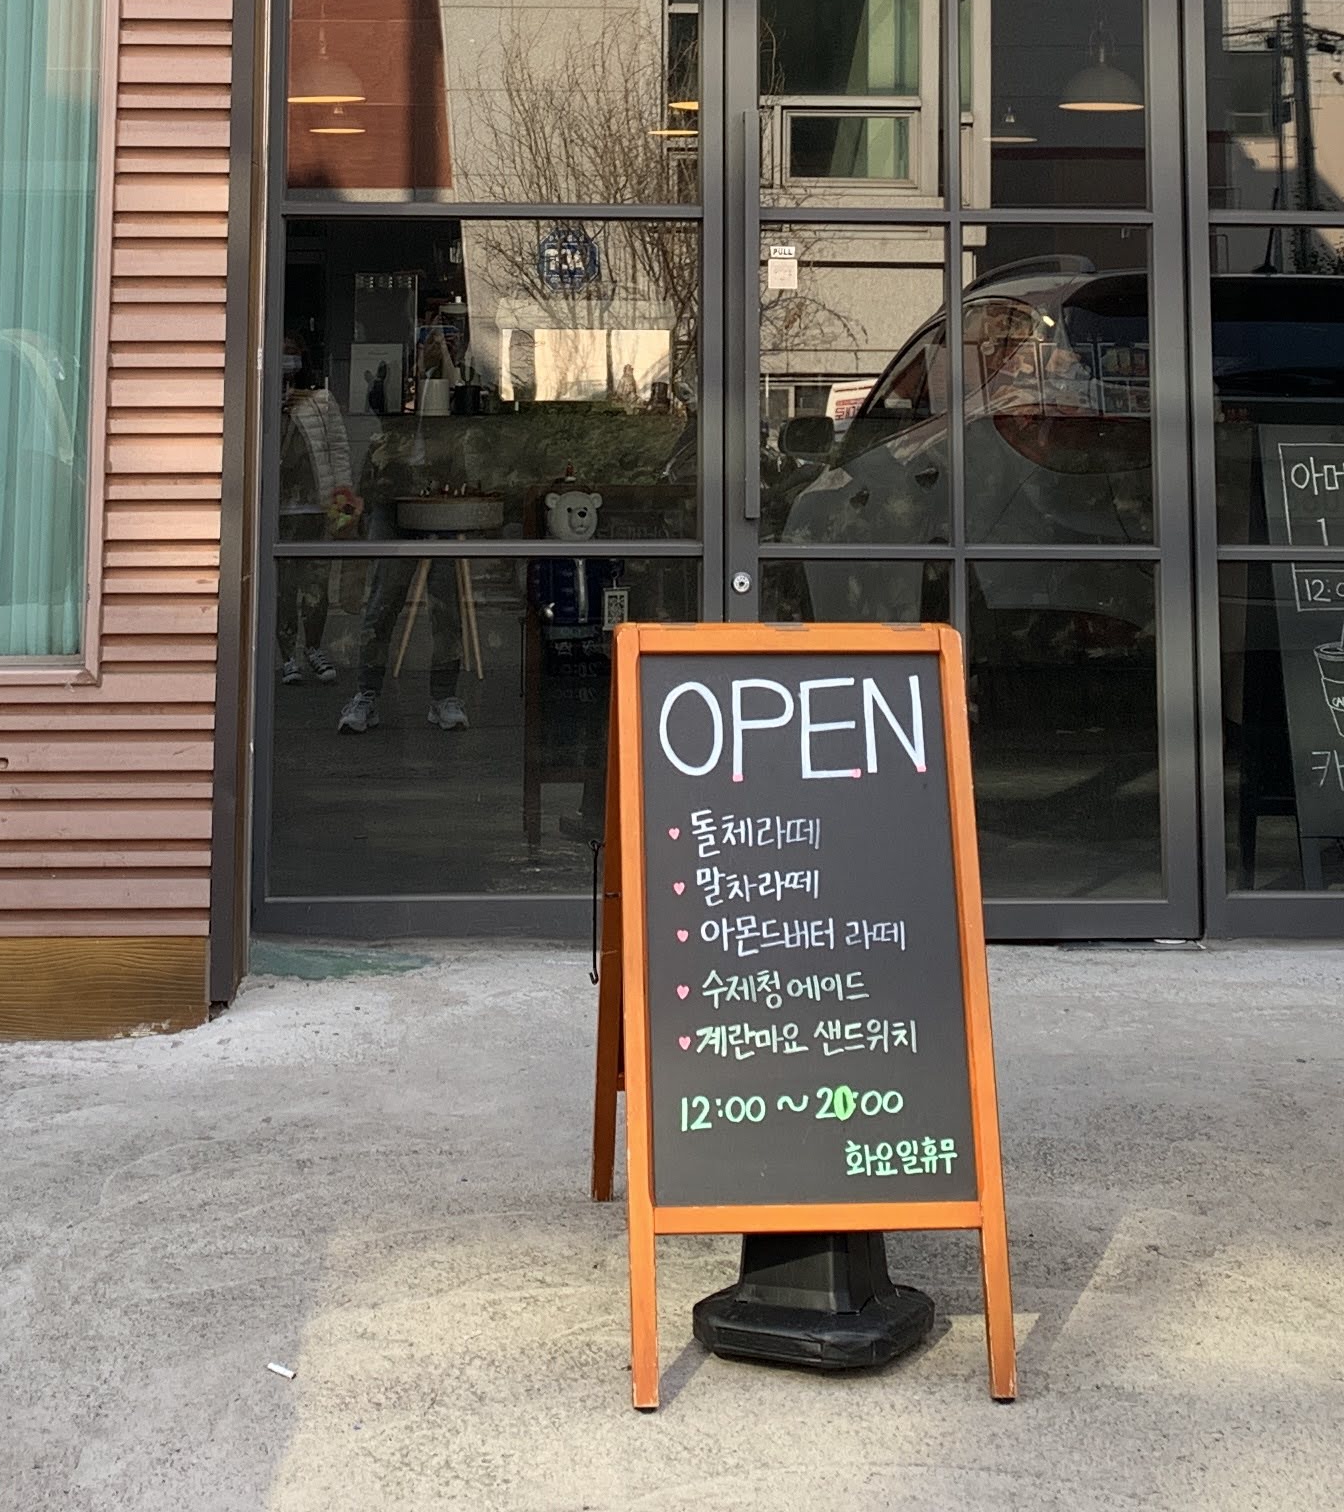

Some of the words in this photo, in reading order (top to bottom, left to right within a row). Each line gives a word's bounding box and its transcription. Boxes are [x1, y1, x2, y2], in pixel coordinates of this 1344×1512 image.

[659, 674, 927, 782] OPEN
[690, 808, 821, 859] 돌체라떼
[695, 865, 820, 908] 말차라떼
[699, 914, 835, 958] 아몬드버터
[845, 918, 906, 952] 라떼
[695, 1022, 809, 1061] 계란마요
[813, 1018, 918, 1056] 샌드위치
[680, 1094, 766, 1132] 12:00
[844, 1135, 958, 1177] 화요일휴무
